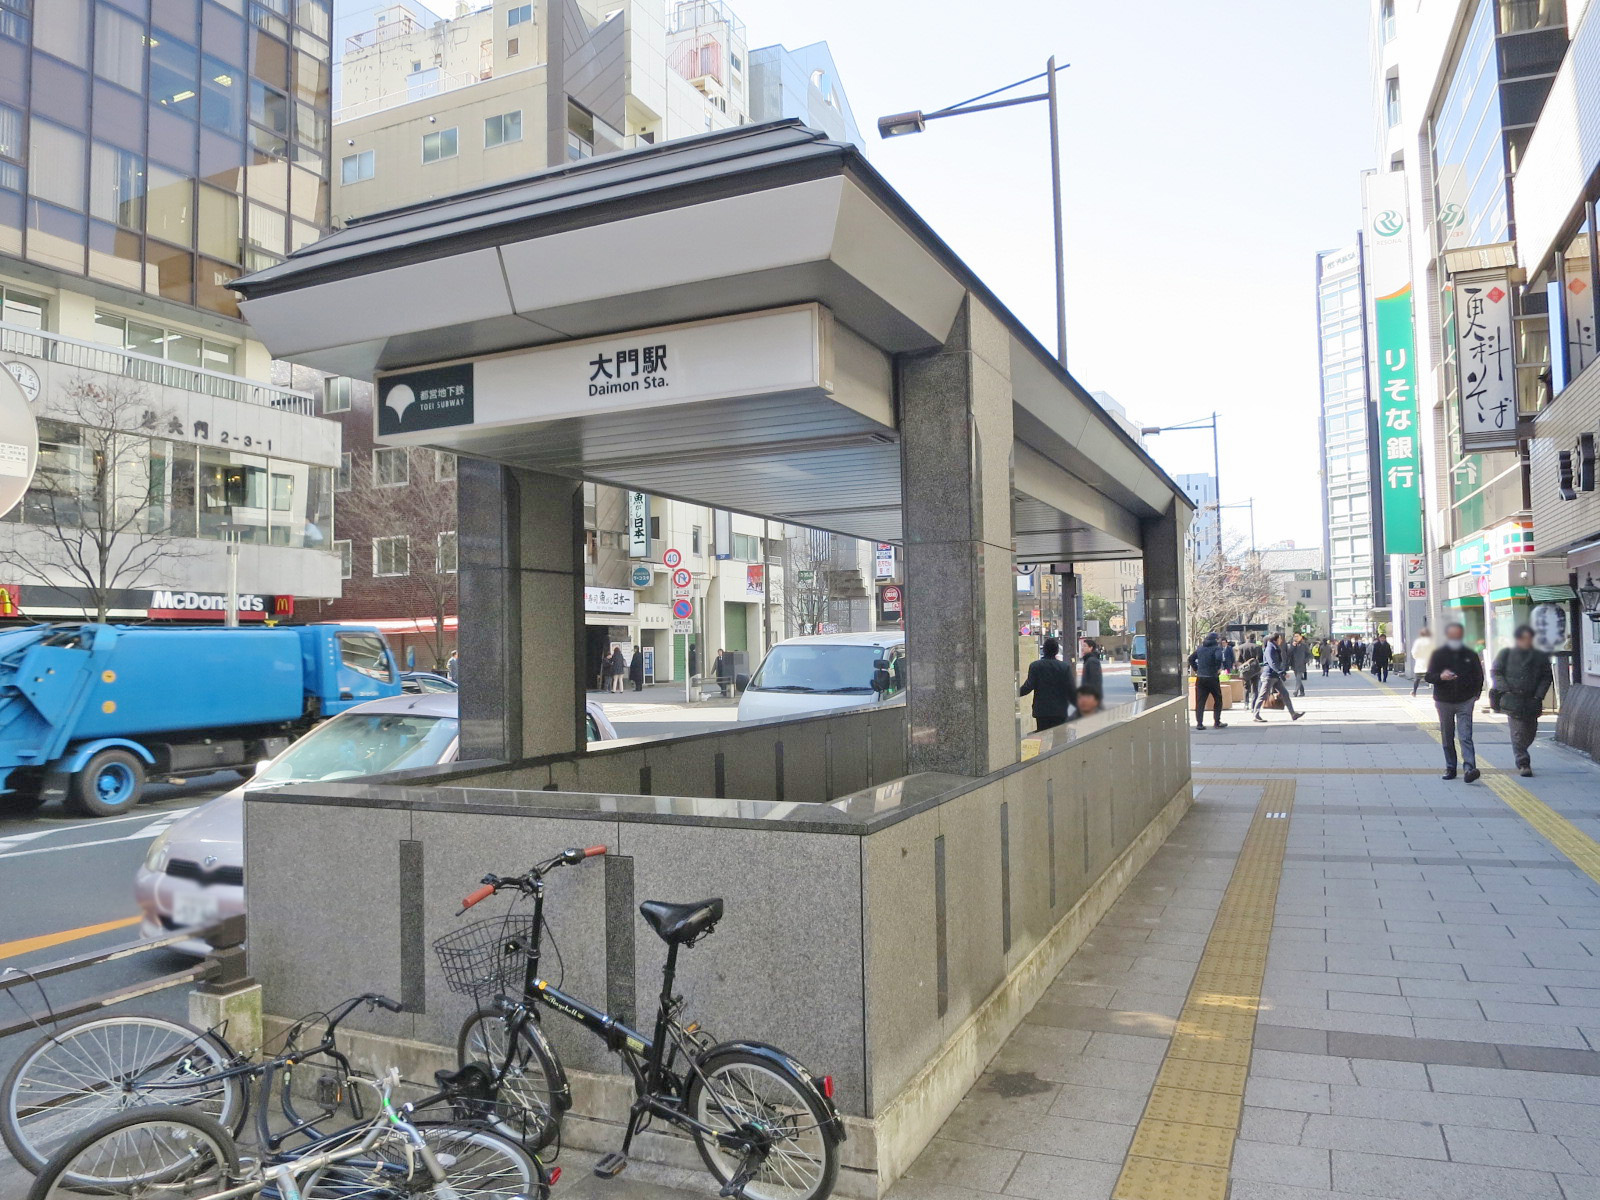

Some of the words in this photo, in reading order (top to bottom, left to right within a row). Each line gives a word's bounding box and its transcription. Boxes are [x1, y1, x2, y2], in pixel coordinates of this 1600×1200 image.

[589, 344, 668, 382] 大門駅
[1463, 287, 1513, 429] 更科そば
[420, 384, 465, 401] 都営地下鉄
[588, 380, 640, 397] Daimon
[643, 376, 669, 390] Sta.
[420, 402, 435, 411] TOEI
[436, 398, 465, 409] SUBWAY
[1384, 348, 1414, 489] りそな銀行
[220, 431, 272, 452] 2-3-1
[633, 492, 646, 545] 魚がし日本一
[667, 553, 678, 563] 40
